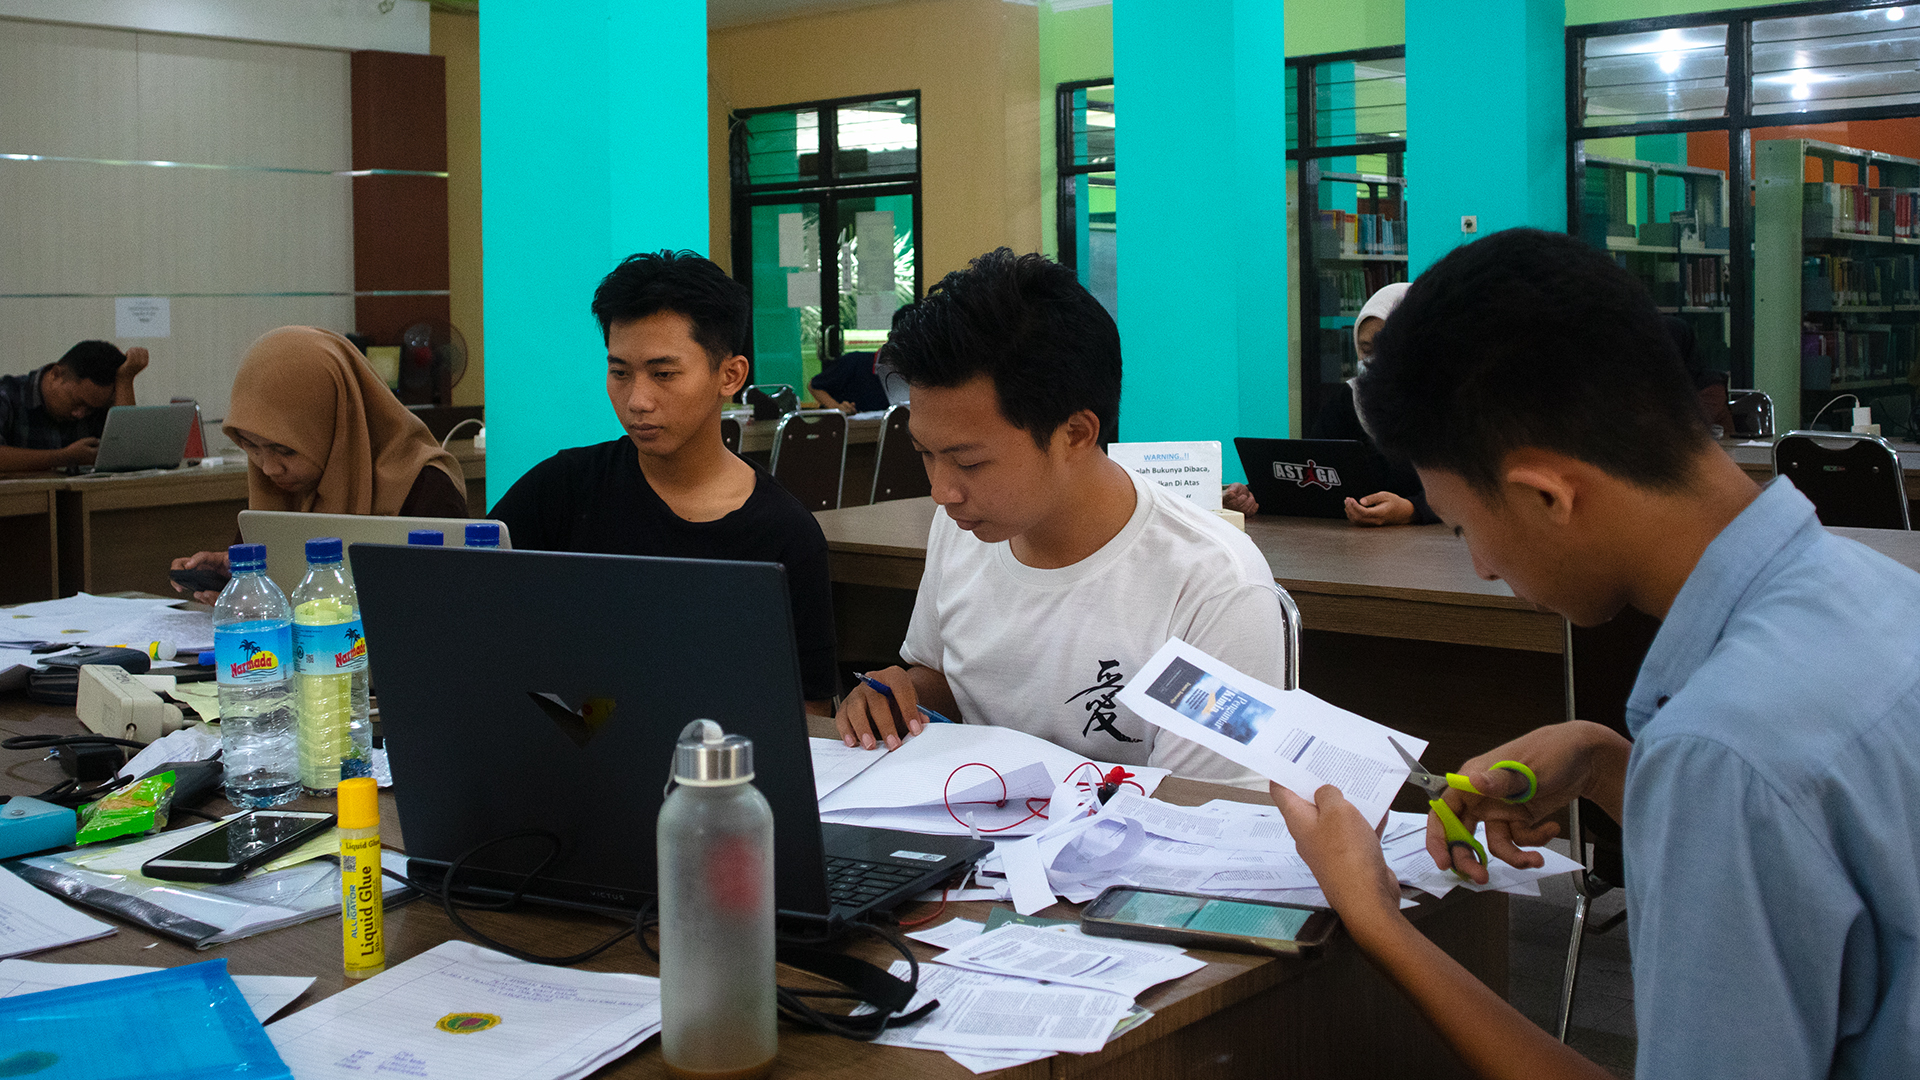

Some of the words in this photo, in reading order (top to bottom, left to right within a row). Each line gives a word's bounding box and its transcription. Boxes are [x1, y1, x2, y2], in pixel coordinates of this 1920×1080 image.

[1152, 467, 1184, 475] Bukunya
[1184, 465, 1210, 474] Dibaca,
[230, 652, 272, 678] Narmada
[1210, 689, 1236, 713] Kimia
[1214, 695, 1248, 730] Pengantar
[345, 842, 367, 852] Liquid
[358, 865, 373, 904] Glue
[350, 884, 358, 939] ALLIGATOR
[358, 906, 377, 957] Liquid
